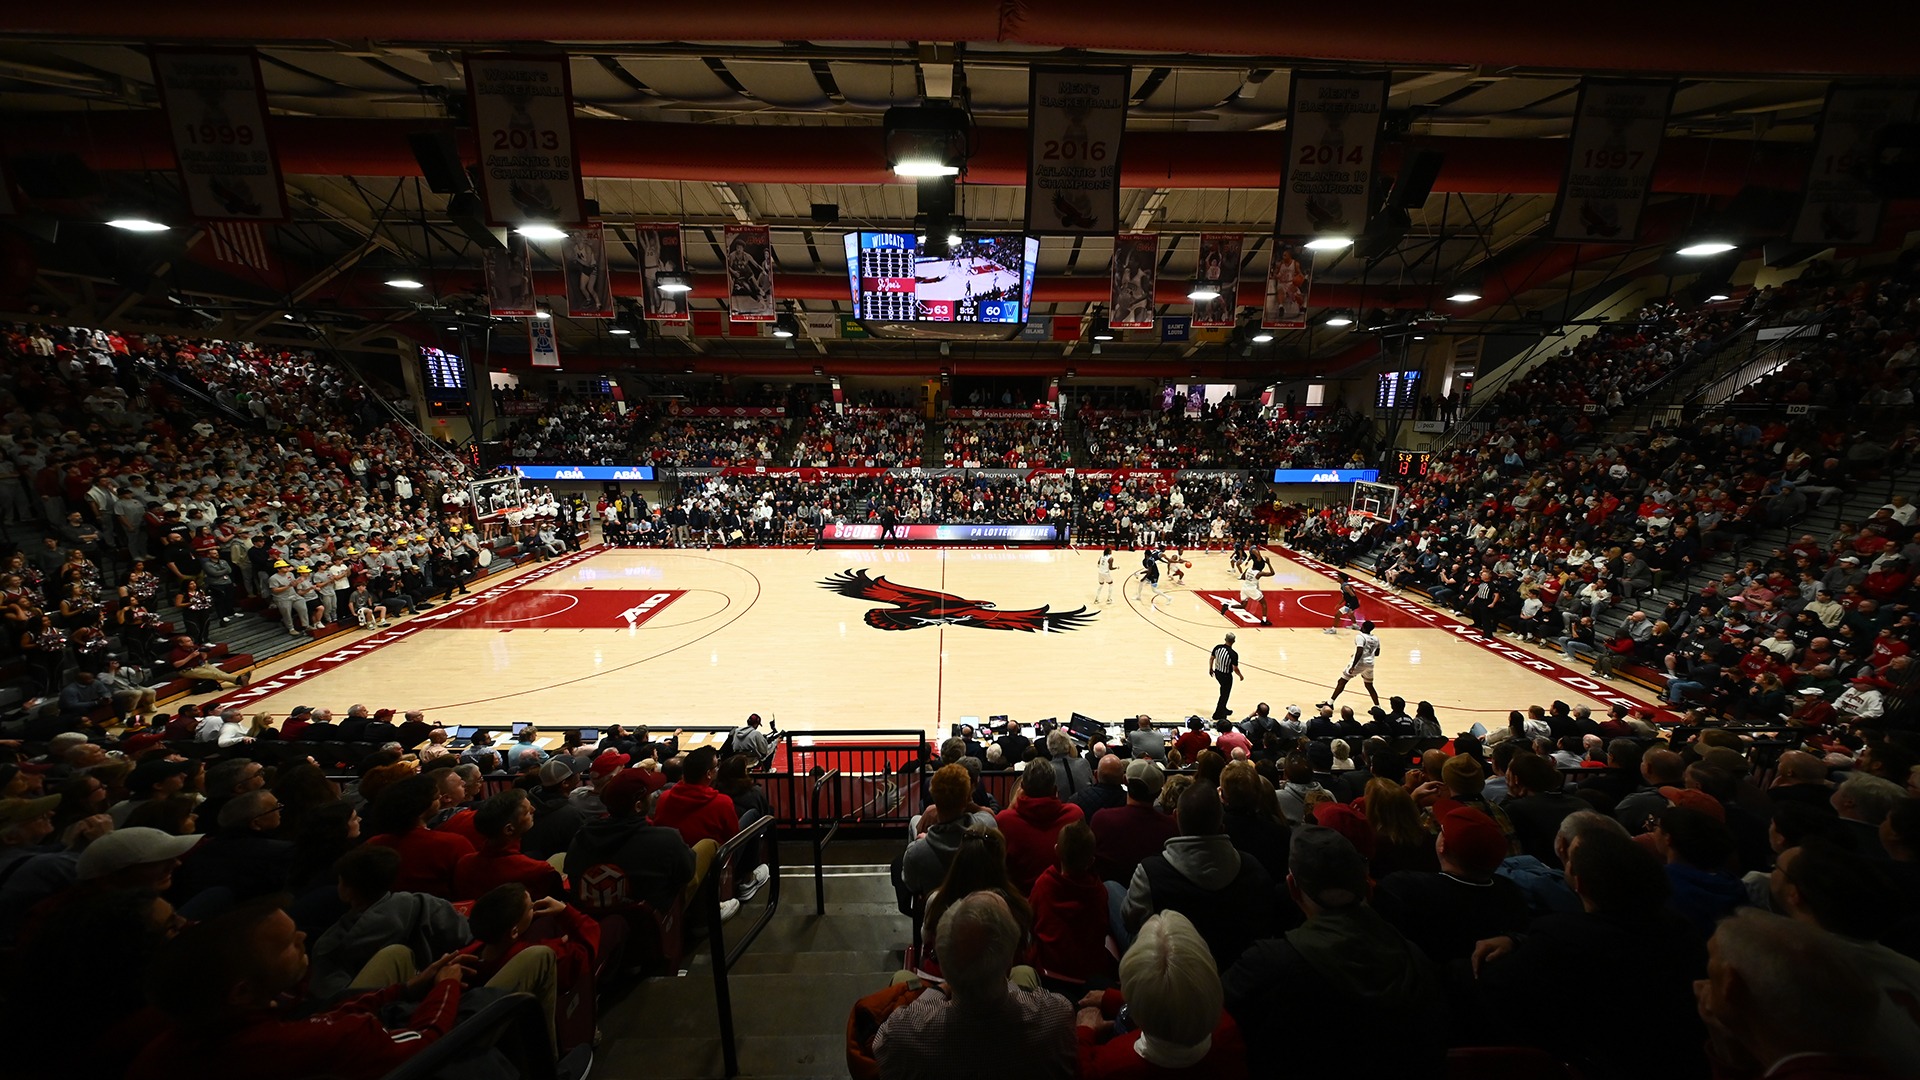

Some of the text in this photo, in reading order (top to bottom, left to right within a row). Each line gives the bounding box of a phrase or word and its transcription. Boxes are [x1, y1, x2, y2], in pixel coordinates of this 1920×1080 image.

[484, 68, 549, 82] WOMEN'S
[478, 83, 563, 98] BASKETBALL
[1059, 82, 1100, 95] MEN'S
[1319, 87, 1360, 100] MEN'S
[1040, 95, 1122, 109] BASKETBALL
[1297, 100, 1380, 114] BASKETBALL
[186, 123, 254, 146] 1999
[492, 129, 560, 151] 2013
[1043, 140, 1107, 161] 2016
[1299, 144, 1364, 165] 2014
[487, 153, 571, 169] ATLANTIC 10
[1584, 148, 1645, 170] 1997
[490, 168, 570, 181] CHAMPIONS
[1035, 163, 1115, 178] ATLANTIC 10
[1291, 168, 1368, 183] ATLANTIC 10
[1038, 177, 1113, 191] CHAMPIONS
[1292, 181, 1364, 195] CHAMPIONS
[872, 233, 905, 249] WILDCATS
[934, 305, 948, 314] 63
[986, 306, 1000, 315] 60
[555, 470, 643, 479] ABM ABM
[1311, 473, 1340, 482] ABM
[834, 525, 879, 538] SCORE
[970, 528, 1049, 537] PA LOTTERY ONLINE
[455, 549, 601, 606] PHILADELPHIA
[1292, 556, 1643, 710] THE HWK WILL NEVER DIE
[318, 627, 419, 663] HILL
